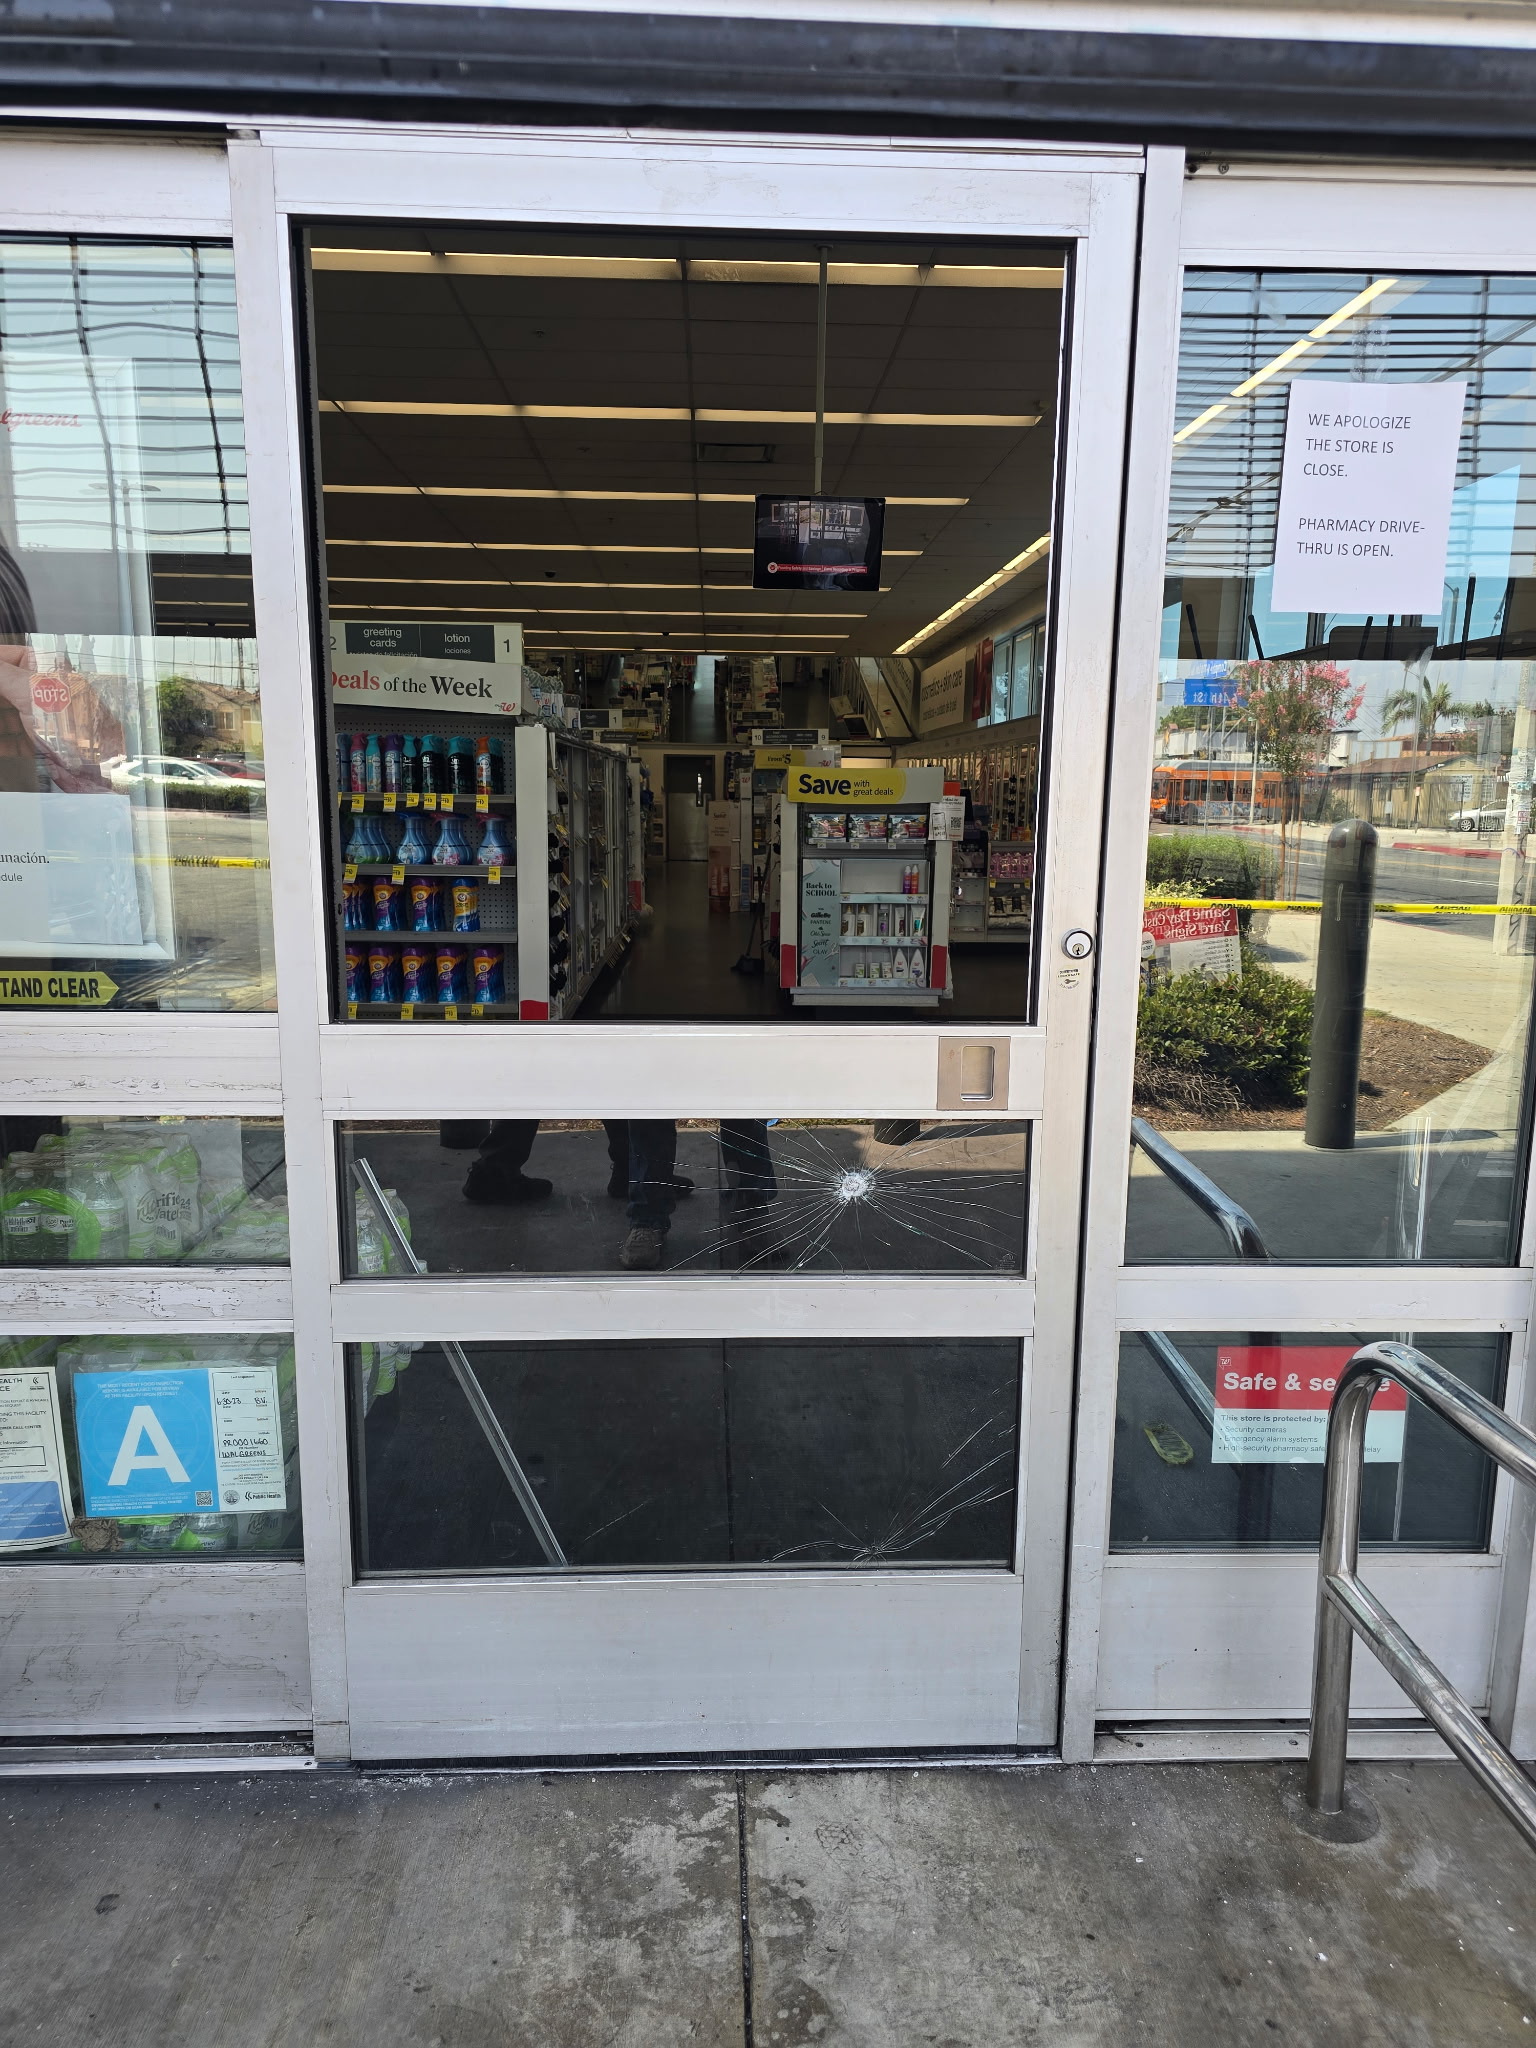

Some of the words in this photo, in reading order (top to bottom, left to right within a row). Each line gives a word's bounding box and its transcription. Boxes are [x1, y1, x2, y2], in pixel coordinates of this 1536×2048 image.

[1308, 413, 1331, 427] WE
[1333, 414, 1412, 429] APOLOGIZE
[1305, 438, 1332, 452] THE
[1335, 439, 1378, 454] STORE
[1382, 441, 1394, 454] IS
[1303, 462, 1348, 477] CLOSE.
[1298, 517, 1376, 533] PHARMACY
[1379, 520, 1426, 533] DRIVE-
[1296, 541, 1333, 555] THRU
[1337, 543, 1349, 556] IS
[1352, 544, 1394, 557] OPEN.
[363, 627, 402, 638] greeting
[444, 633, 471, 643] lotion
[369, 638, 397, 648] cards
[503, 639, 510, 653] 1
[383, 677, 400, 692] of
[402, 677, 427, 694] the
[430, 675, 493, 698] Week
[943, 670, 952, 692] skin
[952, 668, 963, 689] care
[798, 773, 852, 796] Save
[853, 779, 870, 787] with
[853, 788, 873, 797] great
[874, 787, 894, 796] deals
[805, 889, 837, 897] SCHOOL
[0, 977, 43, 998] TAND
[48, 977, 101, 999] CLEAR
[1223, 1372, 1277, 1391] Safe
[1284, 1373, 1301, 1391] &
[1220, 1414, 1238, 1422] This
[1272, 1415, 1312, 1424] protected
[1313, 1416, 1326, 1424] by:
[1225, 1425, 1255, 1434] Security
[1256, 1426, 1287, 1434] cameras
[107, 1405, 191, 1487] A
[1224, 1435, 1264, 1443] Emergency
[1266, 1435, 1286, 1443] alarm
[1288, 1436, 1318, 1444] systems
[221, 1450, 267, 1459] WALGREENS
[1272, 1445, 1308, 1453] pharmacy
